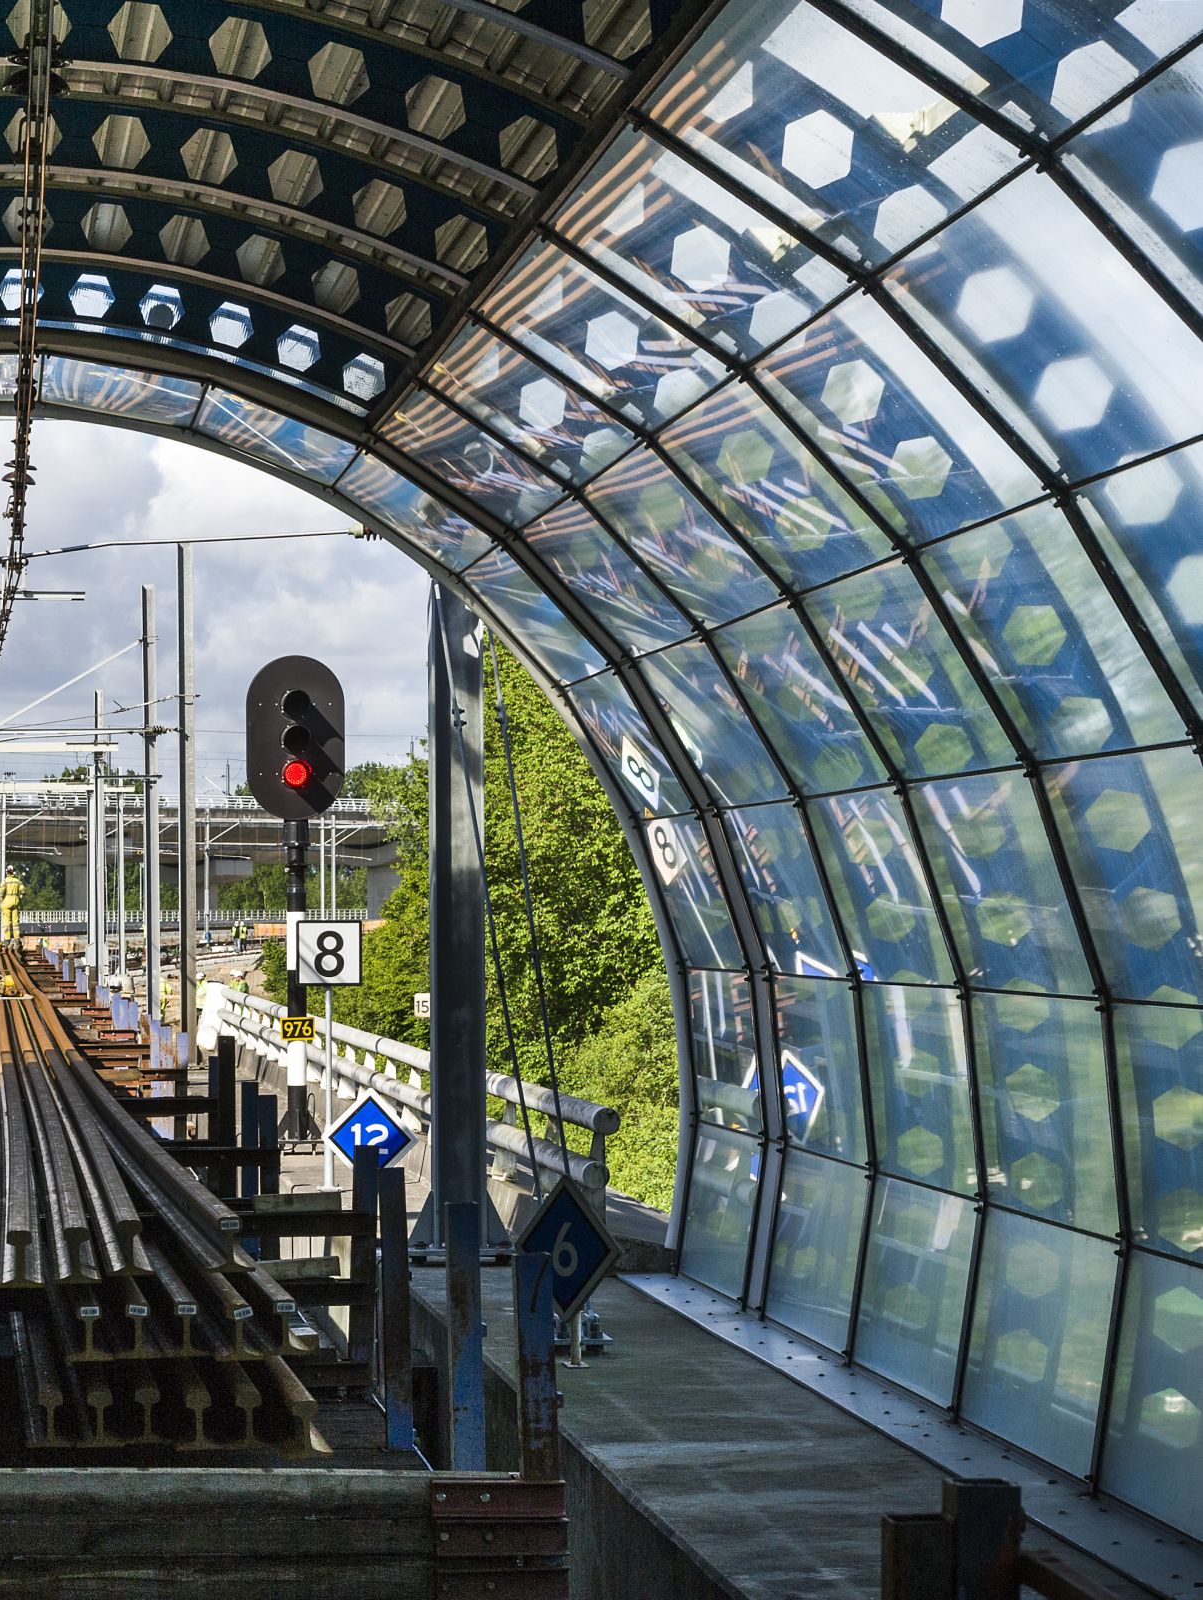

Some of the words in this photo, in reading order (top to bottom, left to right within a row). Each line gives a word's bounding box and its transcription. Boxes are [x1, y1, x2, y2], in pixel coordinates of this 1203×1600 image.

[314, 930, 345, 978] 8
[283, 1021, 312, 1037] 976
[350, 1123, 389, 1155] 12
[552, 1222, 578, 1277] 6
